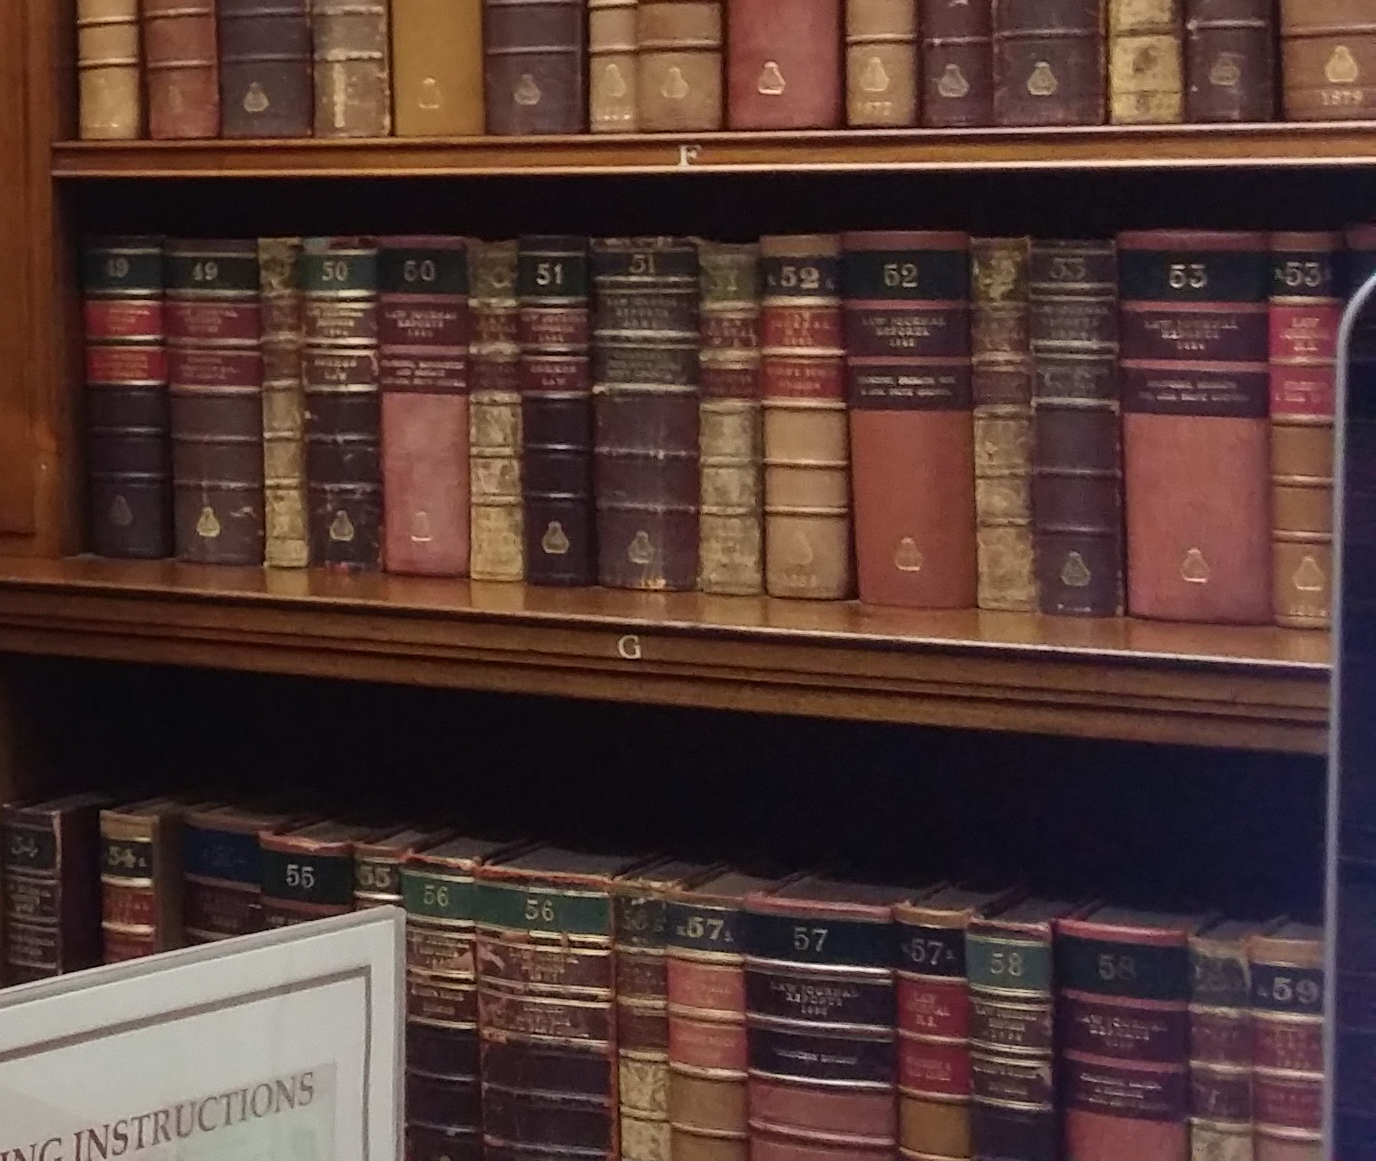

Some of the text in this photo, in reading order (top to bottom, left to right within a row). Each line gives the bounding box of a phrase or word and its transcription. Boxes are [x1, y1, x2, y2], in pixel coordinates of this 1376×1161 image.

[192, 261, 219, 282] 49
[321, 260, 349, 282] 50
[535, 263, 565, 286] 51
[780, 265, 821, 290] 52
[883, 263, 920, 289] 52
[617, 635, 642, 660] G
[285, 864, 315, 889] 55
[423, 884, 449, 908] 56
[524, 898, 555, 922] 56
[686, 915, 724, 941] 57
[793, 926, 829, 952] 57
[990, 951, 1023, 977] 58
[74, 1071, 314, 1161] INSTRUCTIONS
